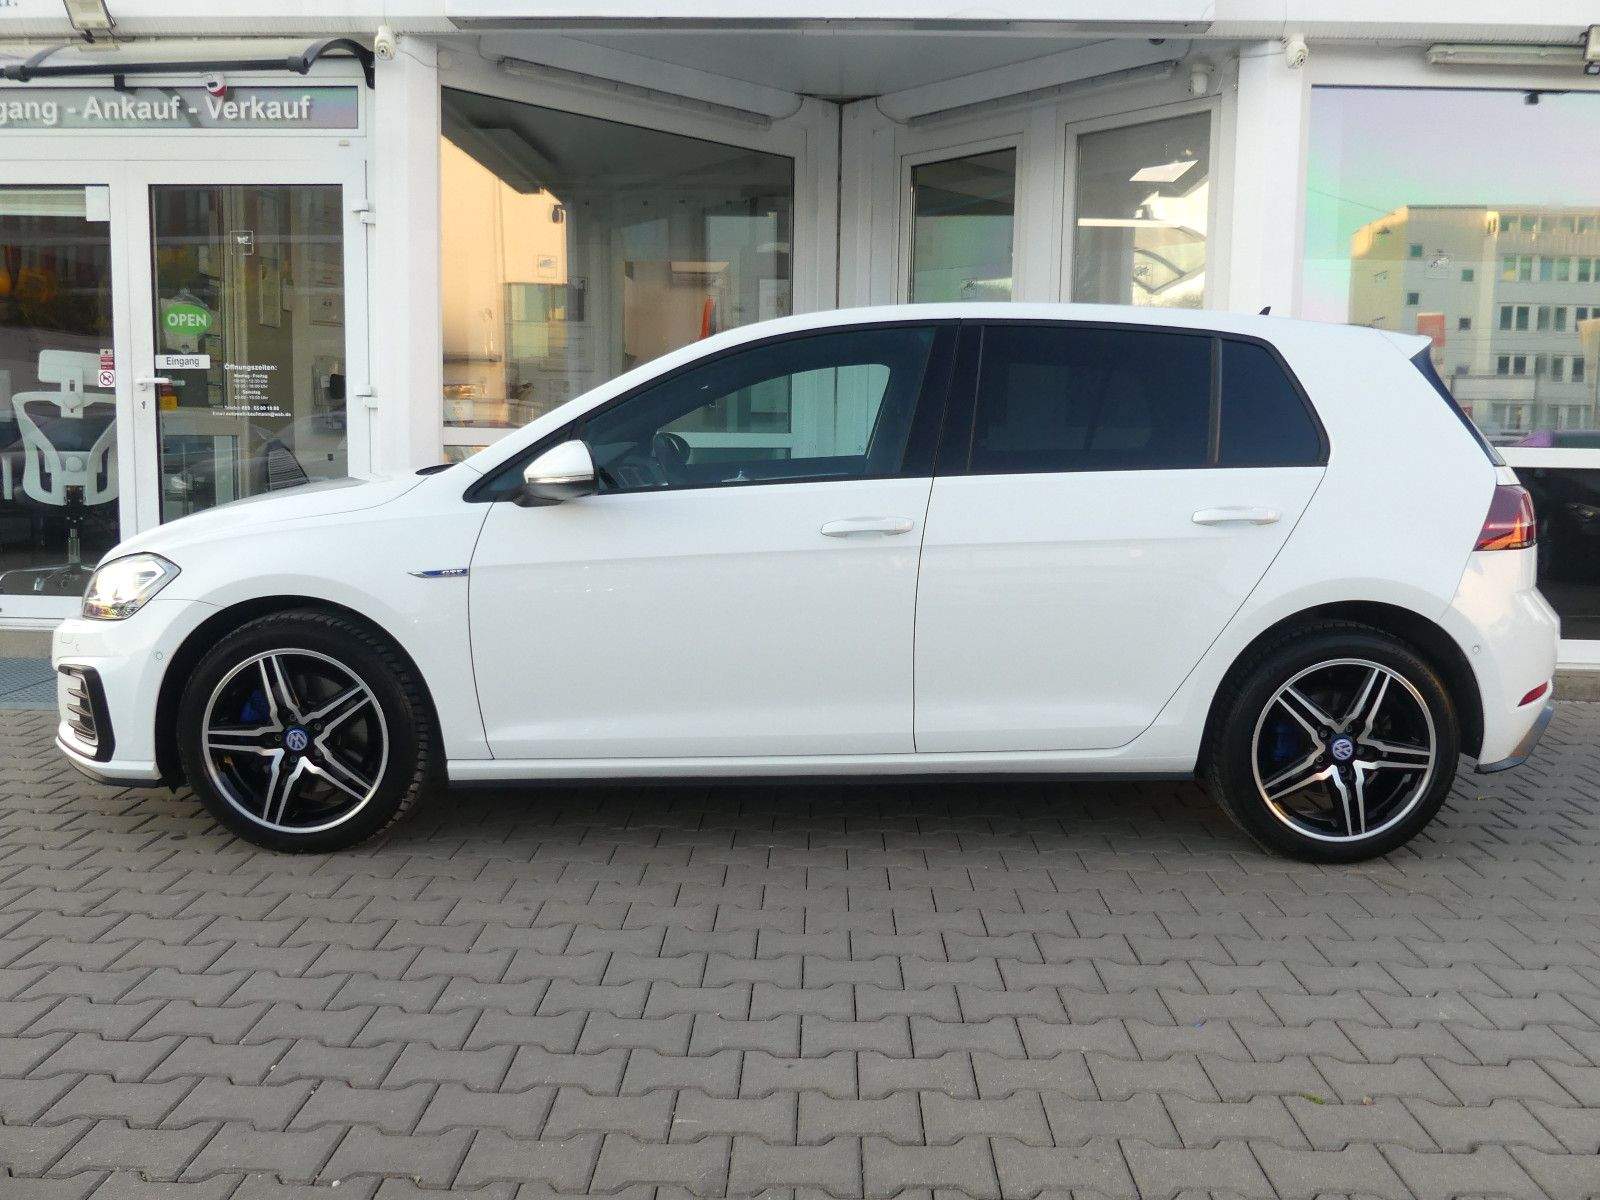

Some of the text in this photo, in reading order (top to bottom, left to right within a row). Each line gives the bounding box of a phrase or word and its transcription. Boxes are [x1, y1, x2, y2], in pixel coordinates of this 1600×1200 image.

[83, 96, 181, 120] Ankauf
[205, 95, 311, 120] Verkauf
[167, 313, 207, 327] OPEN
[166, 356, 200, 367] Eingang
[224, 363, 277, 372] Öffnungszeiten:
